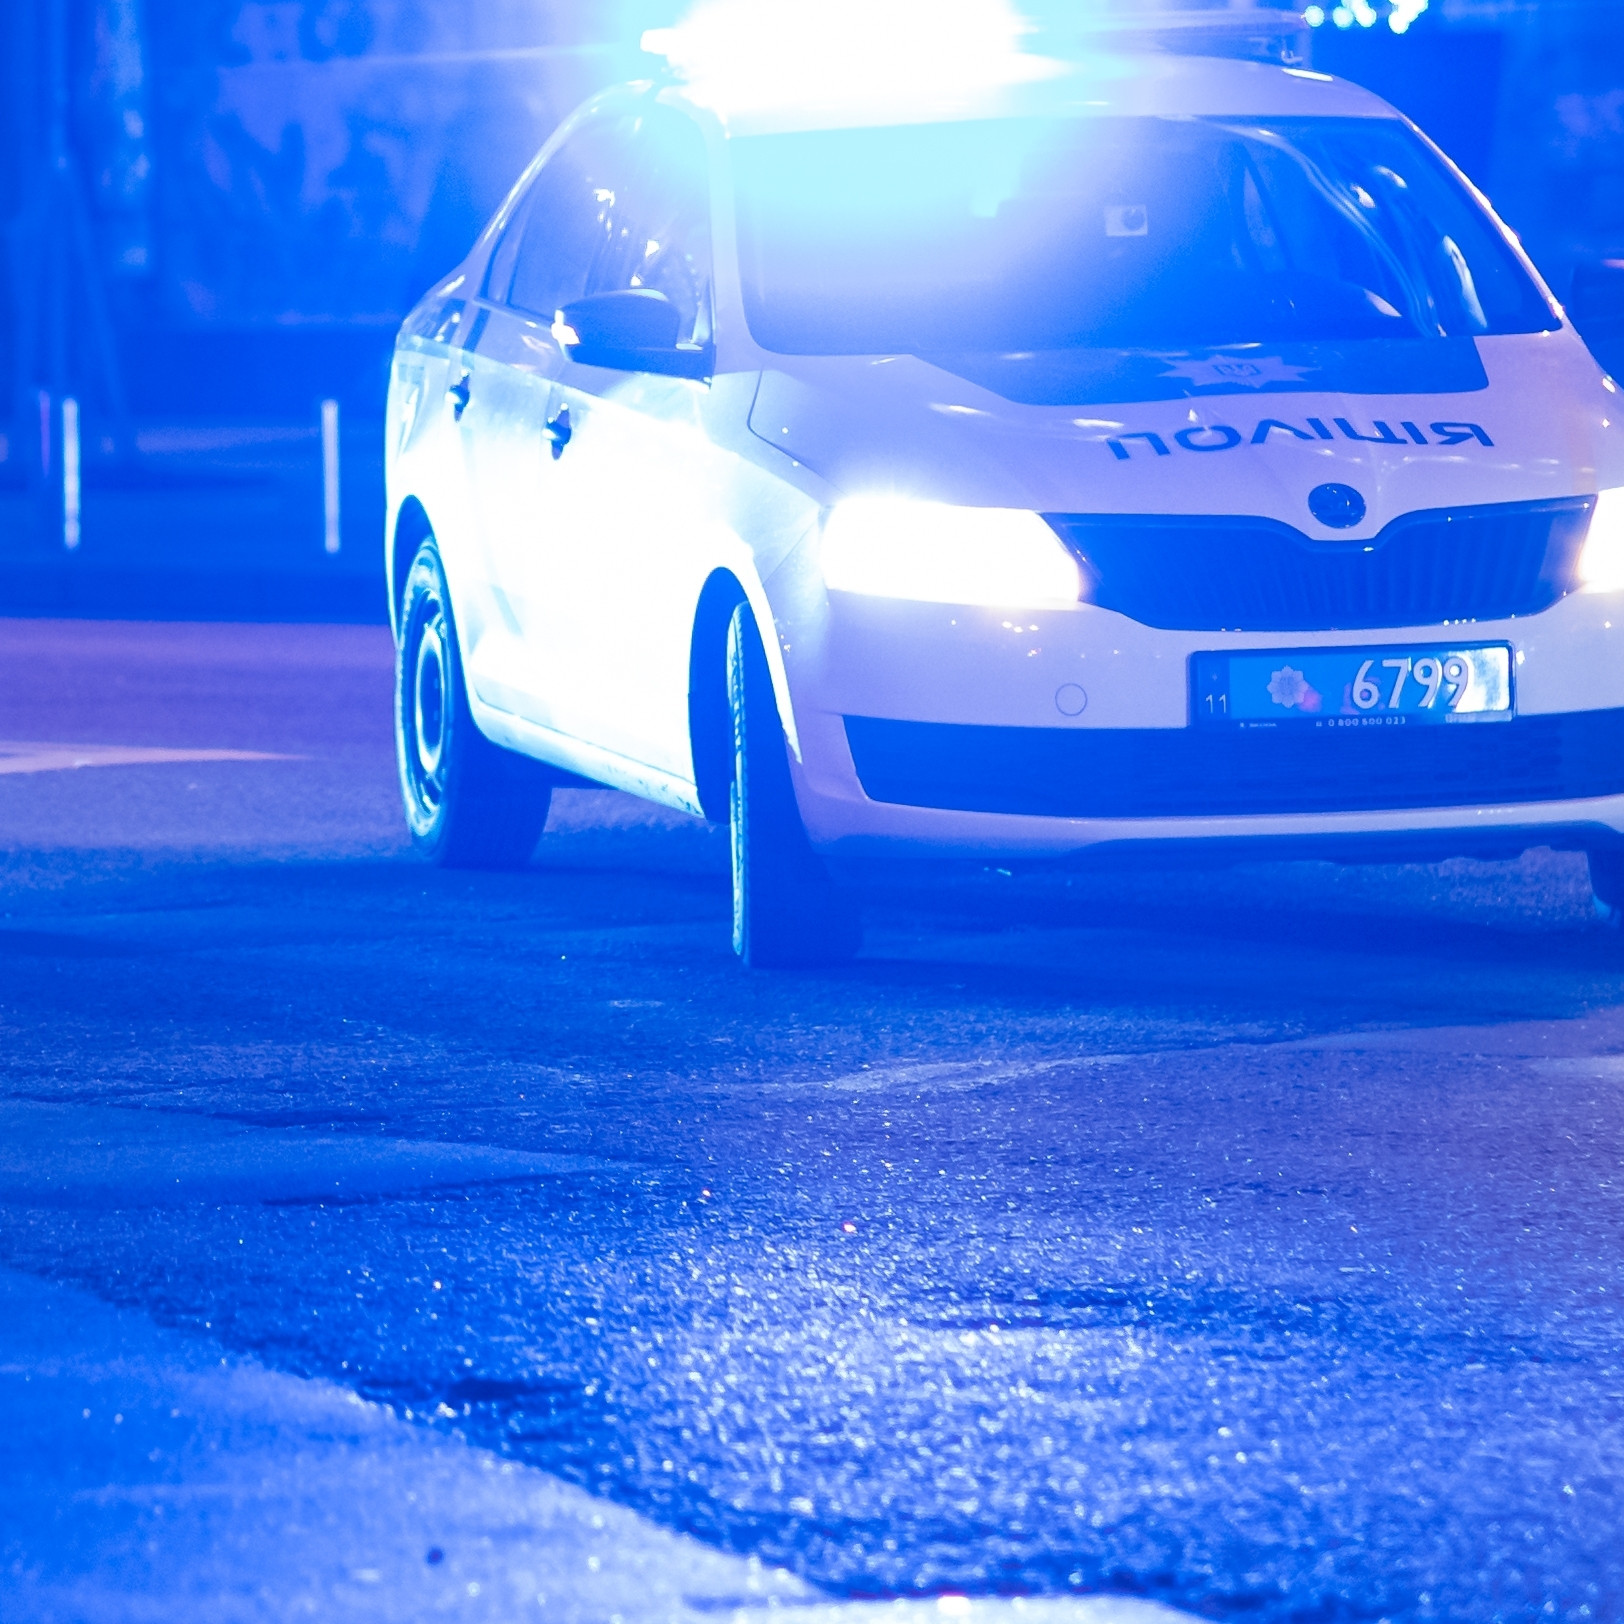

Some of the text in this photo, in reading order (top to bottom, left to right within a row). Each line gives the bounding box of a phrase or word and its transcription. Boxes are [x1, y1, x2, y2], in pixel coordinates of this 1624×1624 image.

[1106, 417, 1495, 460] ПОЛІЦІЯ
[1204, 693, 1227, 714] 11
[1351, 655, 1469, 709] 6799
